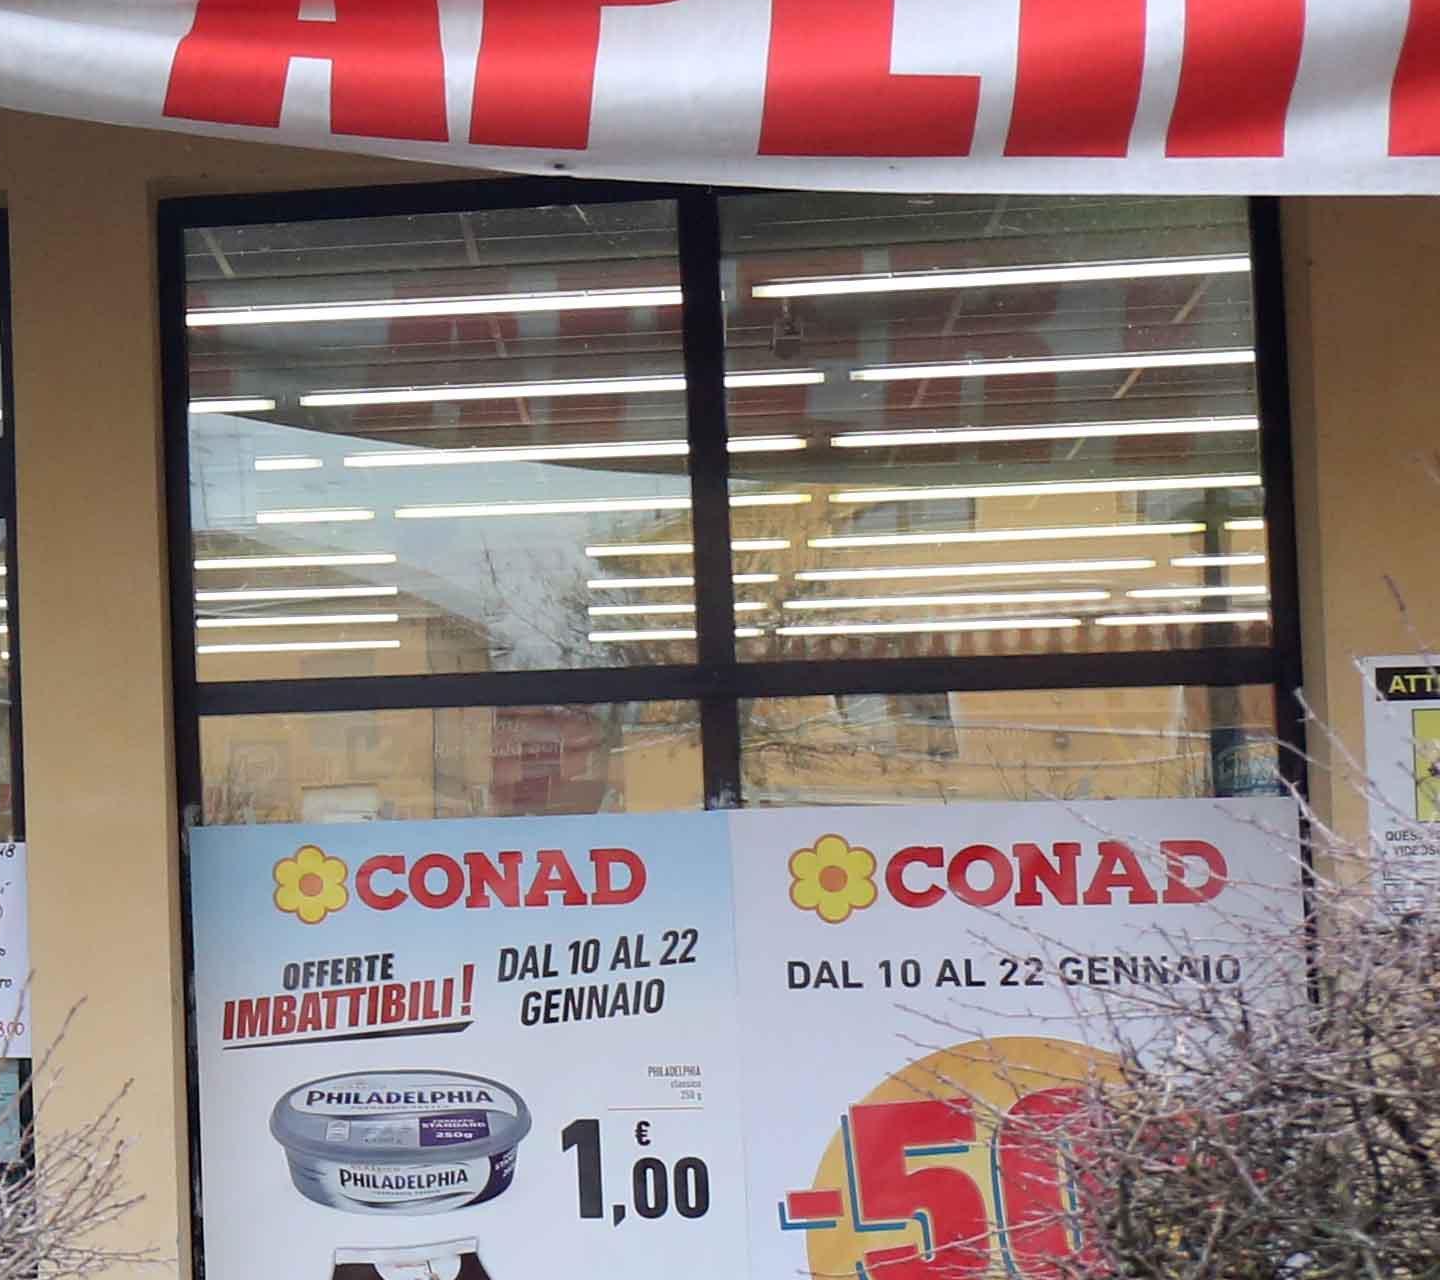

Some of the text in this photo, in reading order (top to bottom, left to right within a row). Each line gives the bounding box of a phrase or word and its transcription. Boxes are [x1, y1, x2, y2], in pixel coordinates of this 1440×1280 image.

[1388, 674, 1440, 694] ATT
[355, 847, 647, 911] CONAD
[885, 840, 1229, 908] CONAD
[282, 953, 395, 991] OFFERTE
[497, 927, 699, 982] DAL 10 AL 22
[787, 953, 1242, 990] DAL 10 AL 22 GENNAIO
[222, 963, 476, 1041] IMBATTIBILI!
[519, 979, 667, 1027] GENNAIO
[305, 1089, 495, 1107] PHILADELPHIA
[634, 1120, 652, 1147] €
[339, 1168, 469, 1190] PHILADELPHIA
[561, 1118, 710, 1228] 1,00
